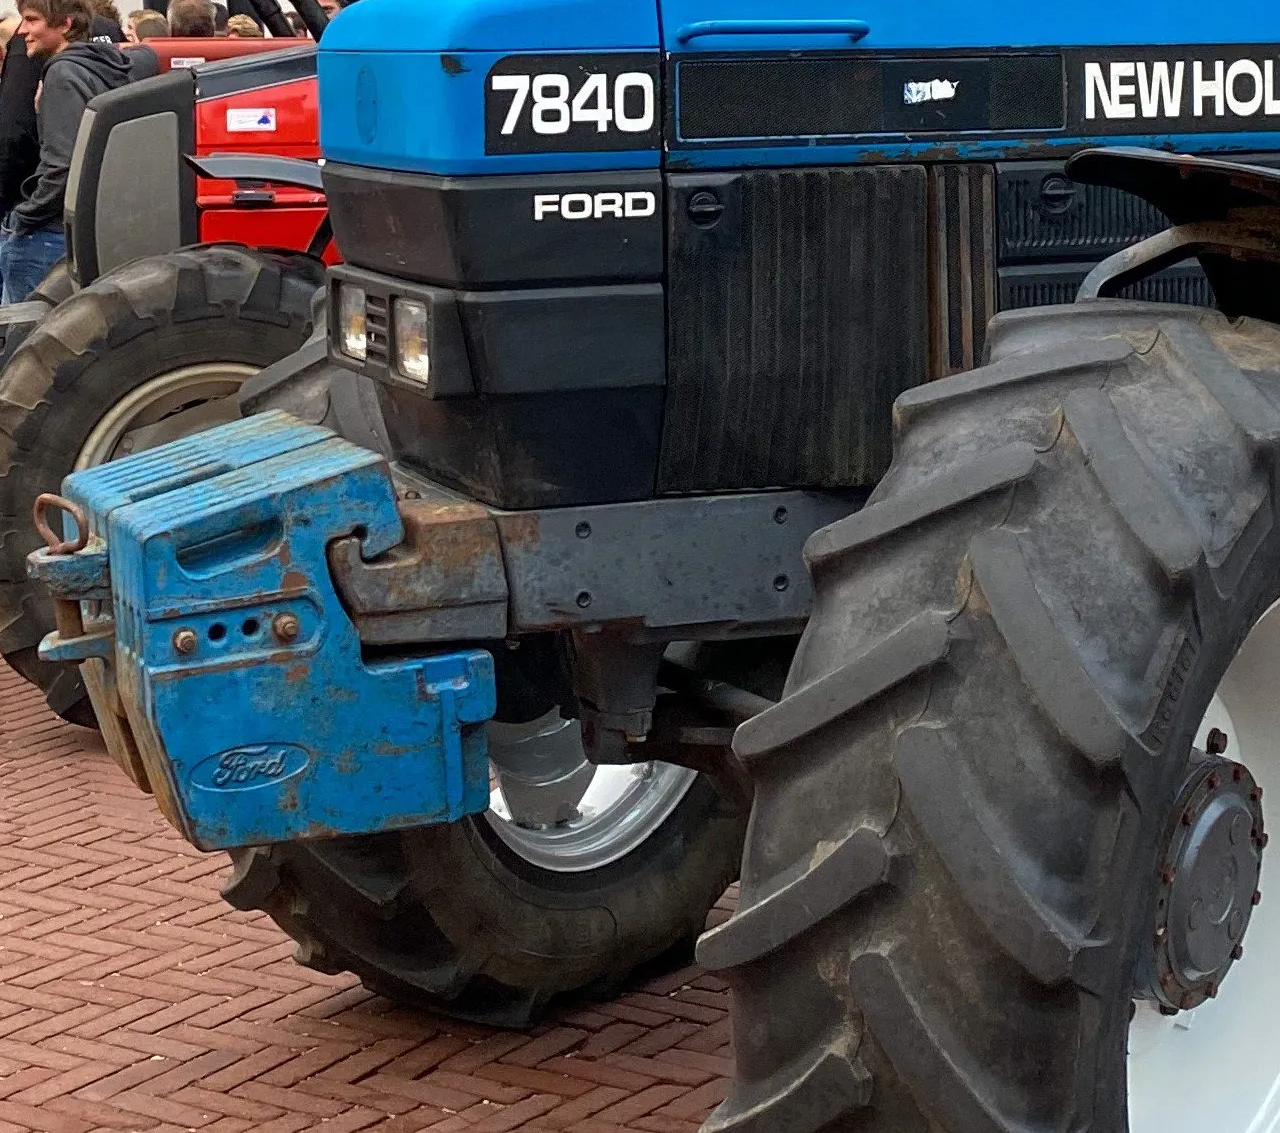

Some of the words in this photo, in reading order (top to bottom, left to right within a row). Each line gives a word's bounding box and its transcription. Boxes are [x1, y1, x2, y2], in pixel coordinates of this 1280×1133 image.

[491, 72, 654, 135] 7840
[1084, 60, 1185, 120] NEW
[533, 191, 656, 222] FORD
[212, 746, 287, 785] Ford
